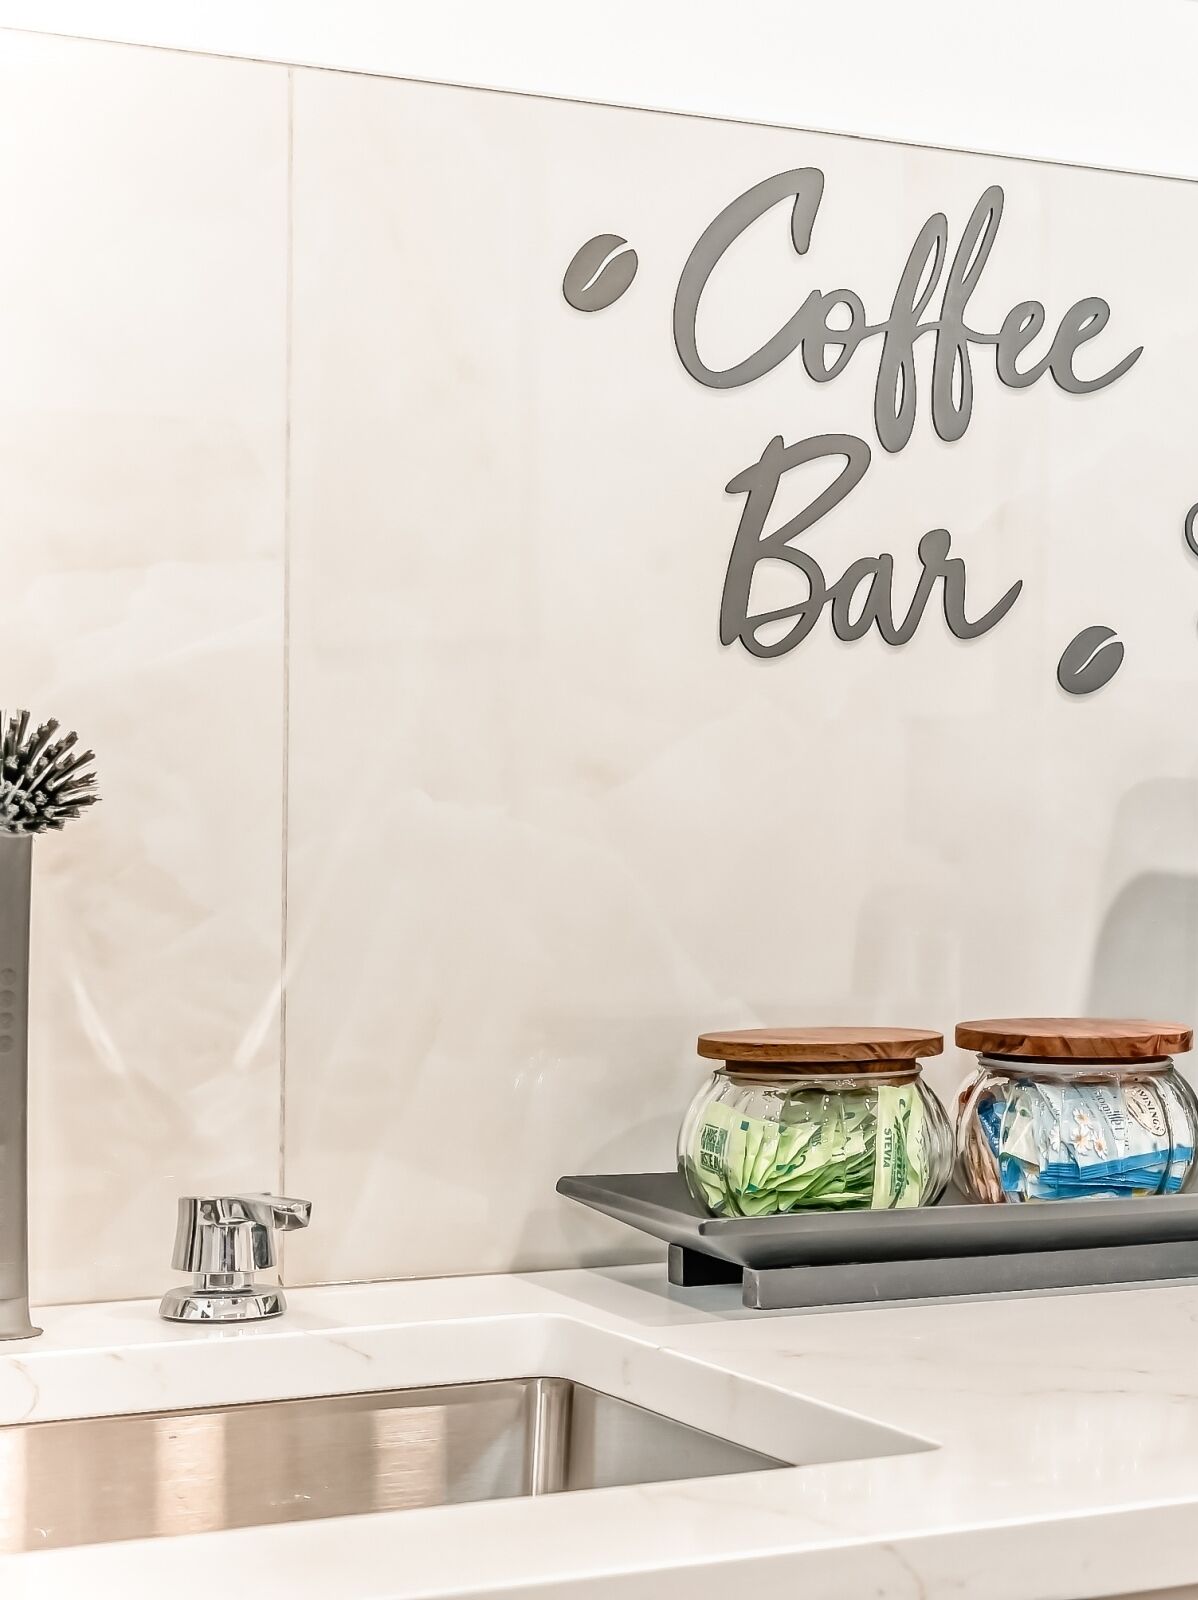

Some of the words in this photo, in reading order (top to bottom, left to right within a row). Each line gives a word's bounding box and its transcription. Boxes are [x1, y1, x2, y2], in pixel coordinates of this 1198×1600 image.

[674, 166, 1143, 454] Coffee
[719, 433, 1023, 659] Bar
[883, 1127, 893, 1168] STEVIA
